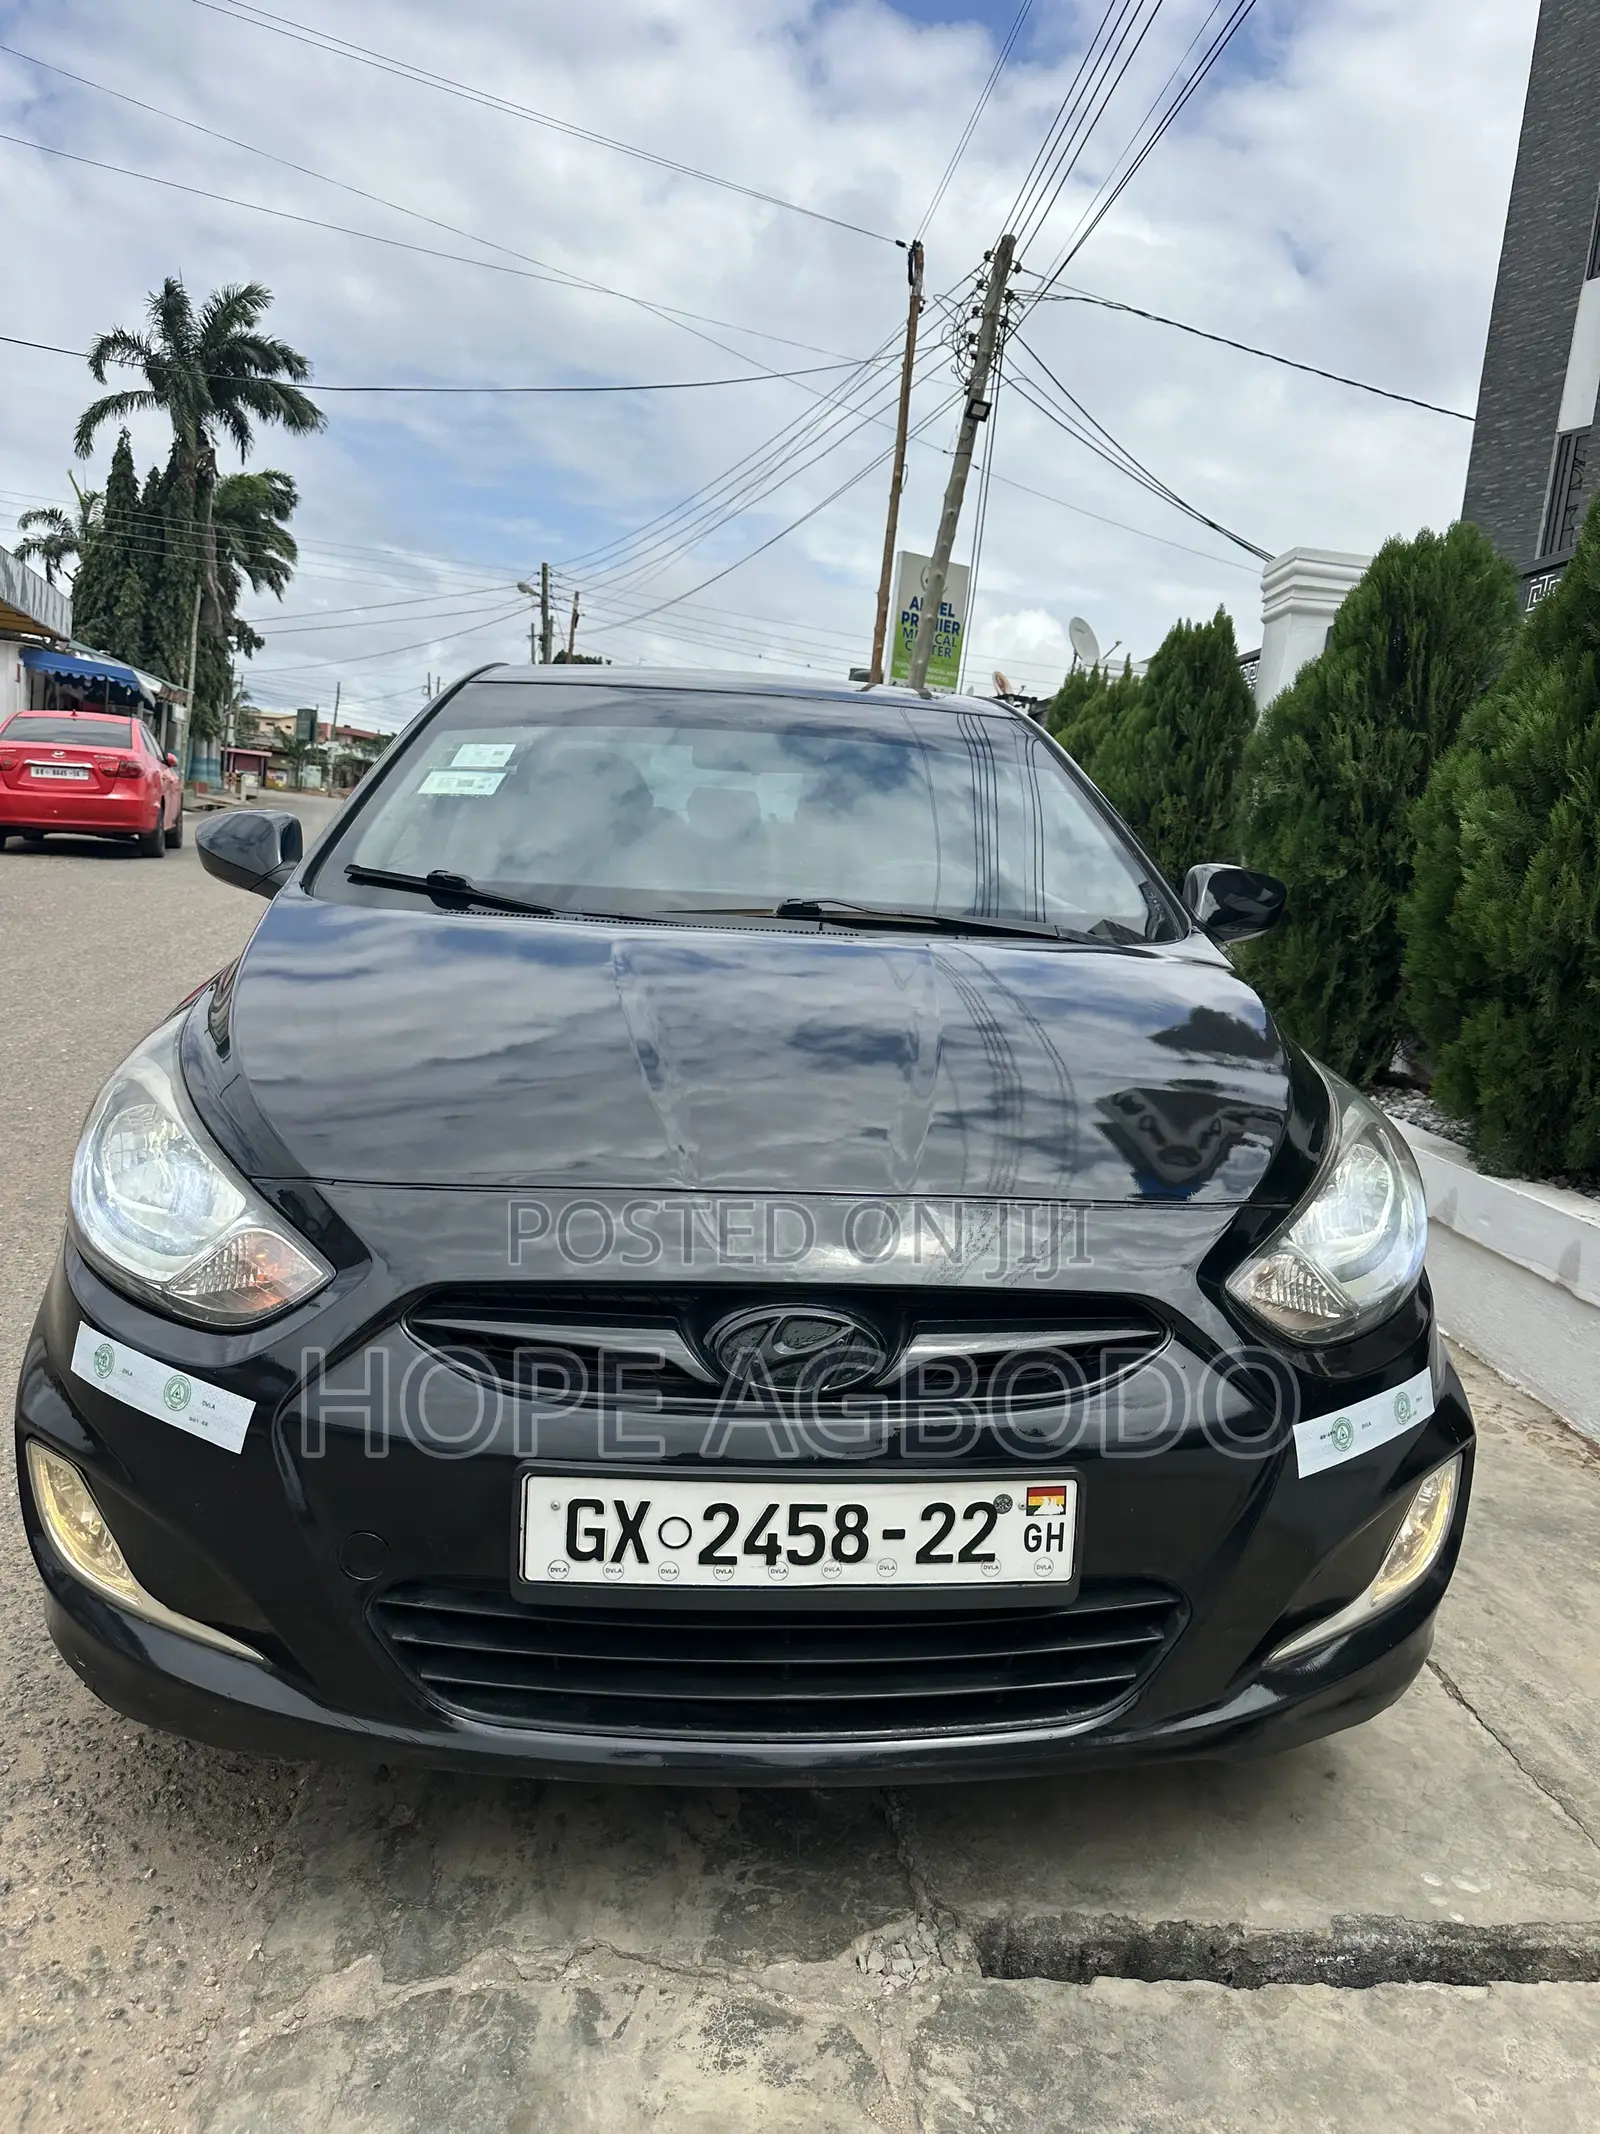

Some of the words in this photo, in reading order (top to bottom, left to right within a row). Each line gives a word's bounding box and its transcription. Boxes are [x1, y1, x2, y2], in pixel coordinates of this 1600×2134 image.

[909, 596, 955, 618] AEL
[901, 610, 960, 636] PRIER
[905, 639, 952, 659] CTER
[566, 1498, 651, 1564] GX
[698, 1502, 998, 1566] 2458-22
[1024, 1522, 1065, 1554] GH
